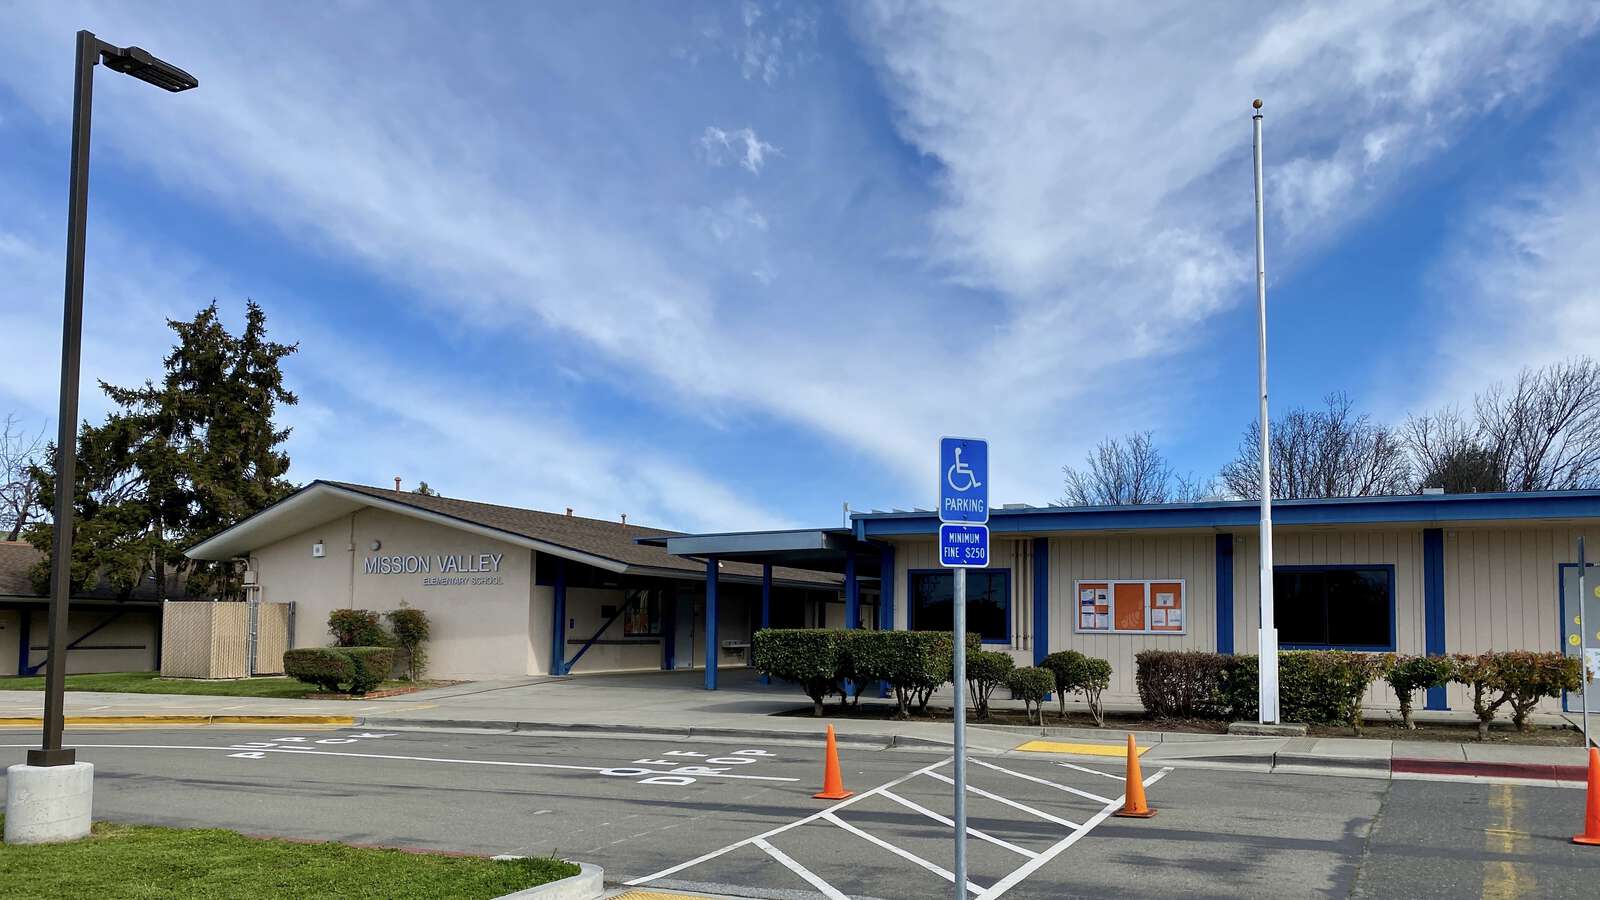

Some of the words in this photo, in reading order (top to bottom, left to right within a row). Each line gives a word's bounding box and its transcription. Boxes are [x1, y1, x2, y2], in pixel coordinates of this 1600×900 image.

[945, 497, 984, 513] PARKING
[949, 532, 980, 544] MINIMUM
[944, 546, 960, 558] FINE
[363, 554, 431, 575] MISSION
[437, 553, 503, 573] VALLEY
[472, 576, 503, 586] SCHOOL
[599, 750, 709, 776] OFF
[636, 749, 777, 786] DROP
